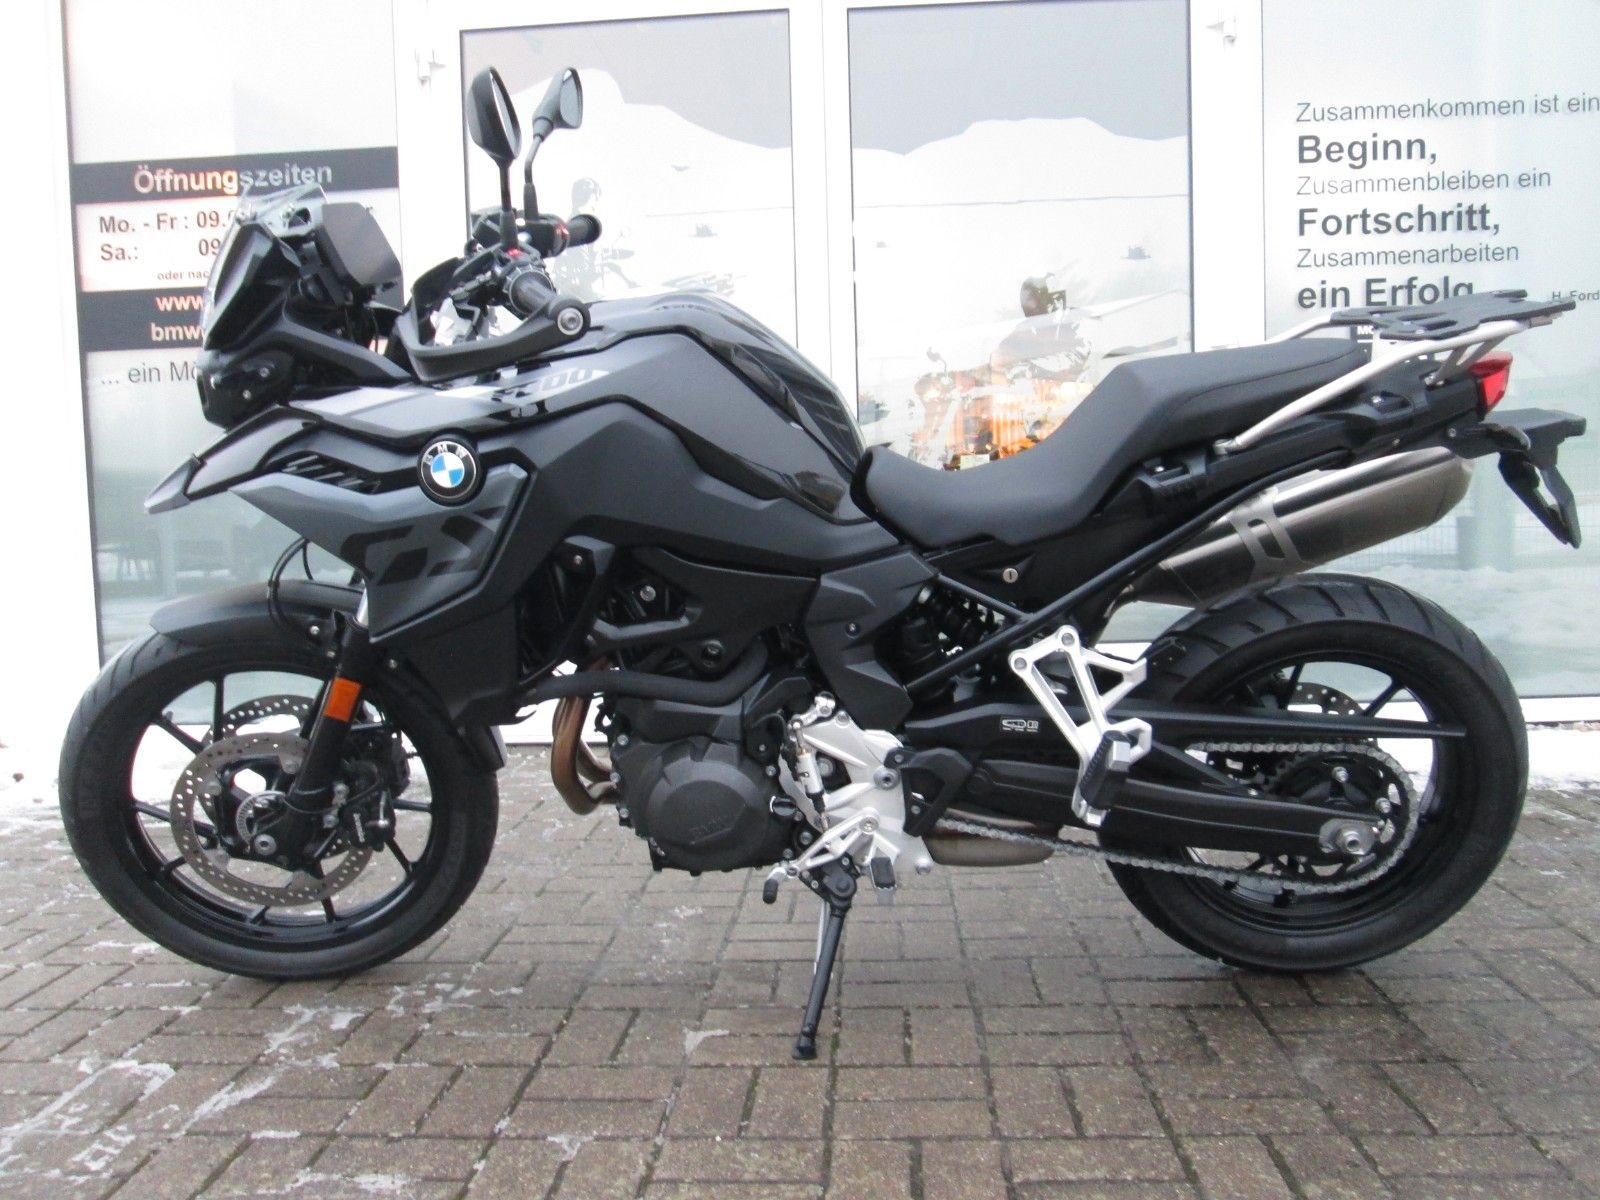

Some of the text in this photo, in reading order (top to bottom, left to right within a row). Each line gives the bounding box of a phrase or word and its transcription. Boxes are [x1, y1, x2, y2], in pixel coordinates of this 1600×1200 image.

[1296, 98, 1525, 122] Zusammenkommen
[1534, 94, 1559, 113] ist
[1298, 132, 1437, 170] Beginn,
[134, 163, 333, 195] Öffnungszeiten
[1296, 167, 1551, 196] Zusammenbleiben ein
[99, 215, 136, 233] Mo.
[156, 212, 178, 230] Fr
[196, 209, 234, 229] 09.
[1298, 202, 1501, 236] Fortschritt,
[1296, 243, 1520, 268] Zusammenarbeiten
[156, 271, 184, 281] oder
[1298, 279, 1351, 309] ein
[1570, 290, 1600, 301] Ford
[128, 362, 160, 383] ein
[422, 441, 468, 466] BMW
